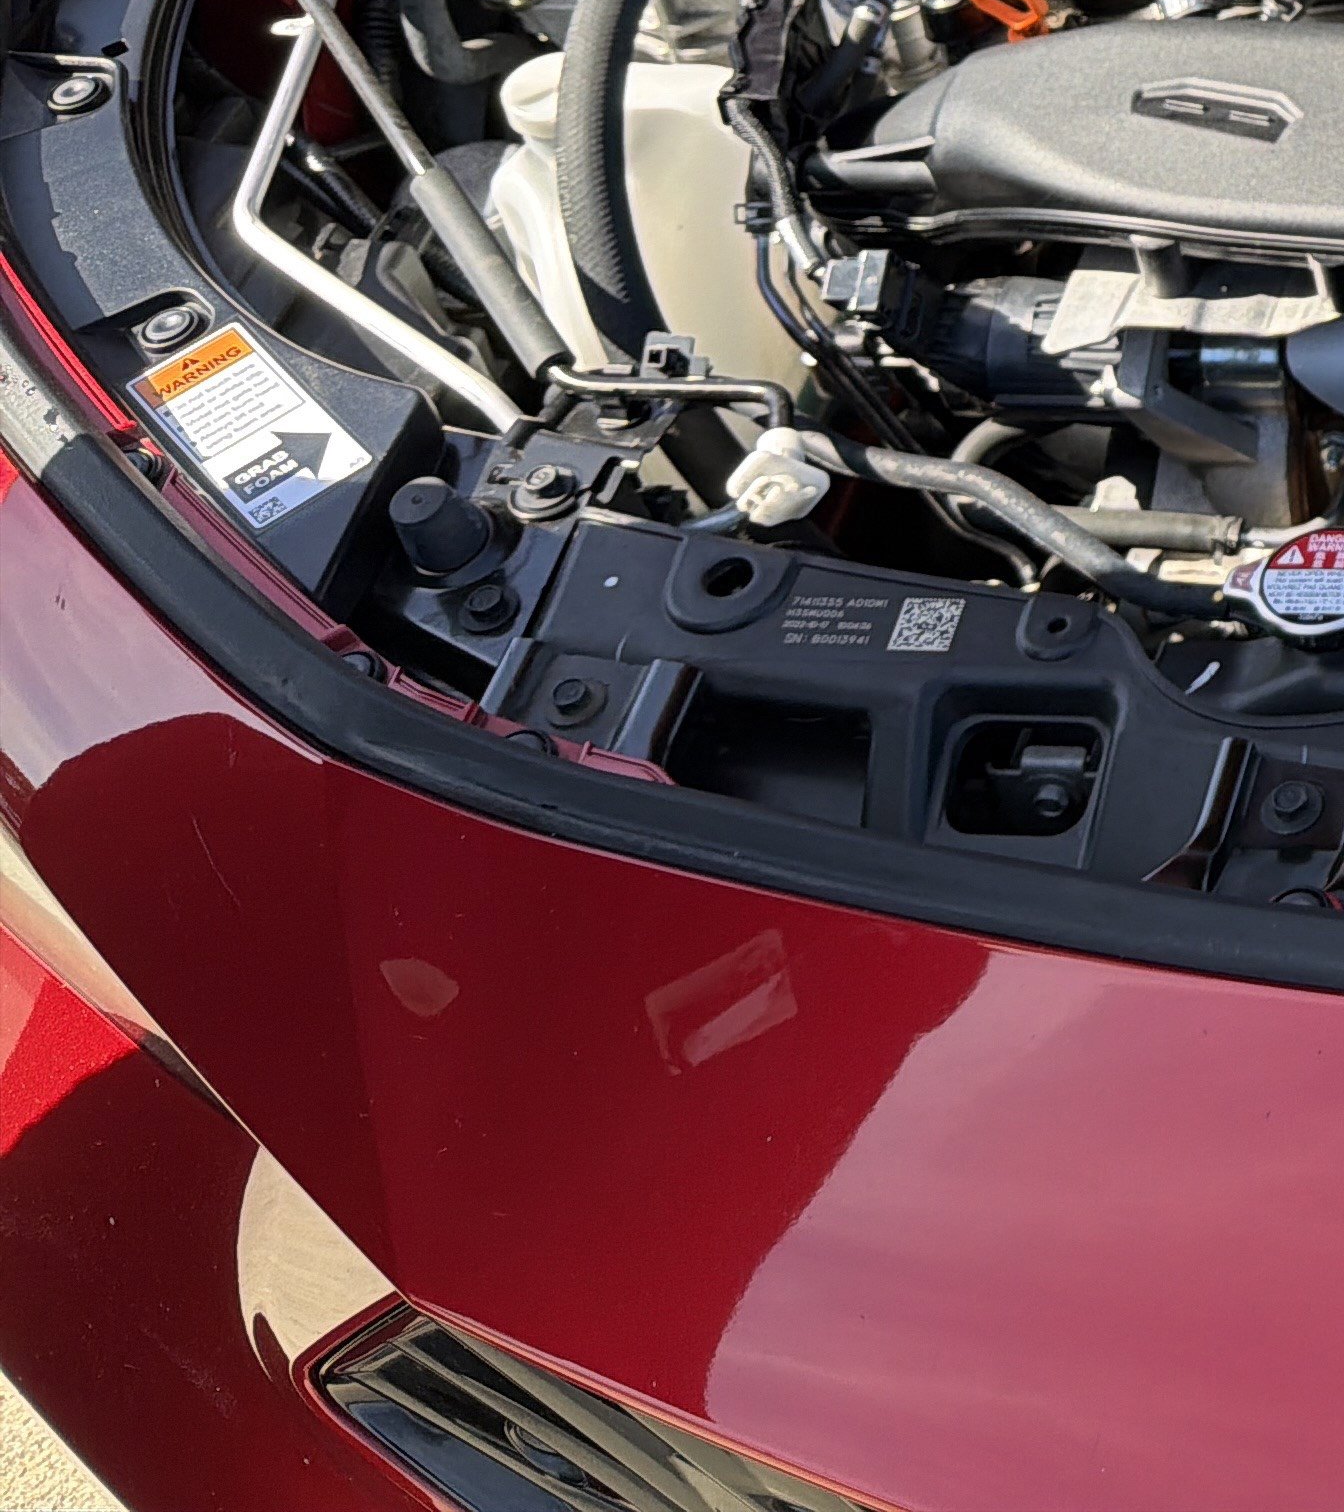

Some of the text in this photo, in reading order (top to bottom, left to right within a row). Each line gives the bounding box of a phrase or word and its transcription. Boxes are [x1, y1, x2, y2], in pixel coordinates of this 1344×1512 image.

[151, 345, 243, 398] WARNING
[234, 450, 290, 486] GRAB
[243, 459, 299, 495] FOAM
